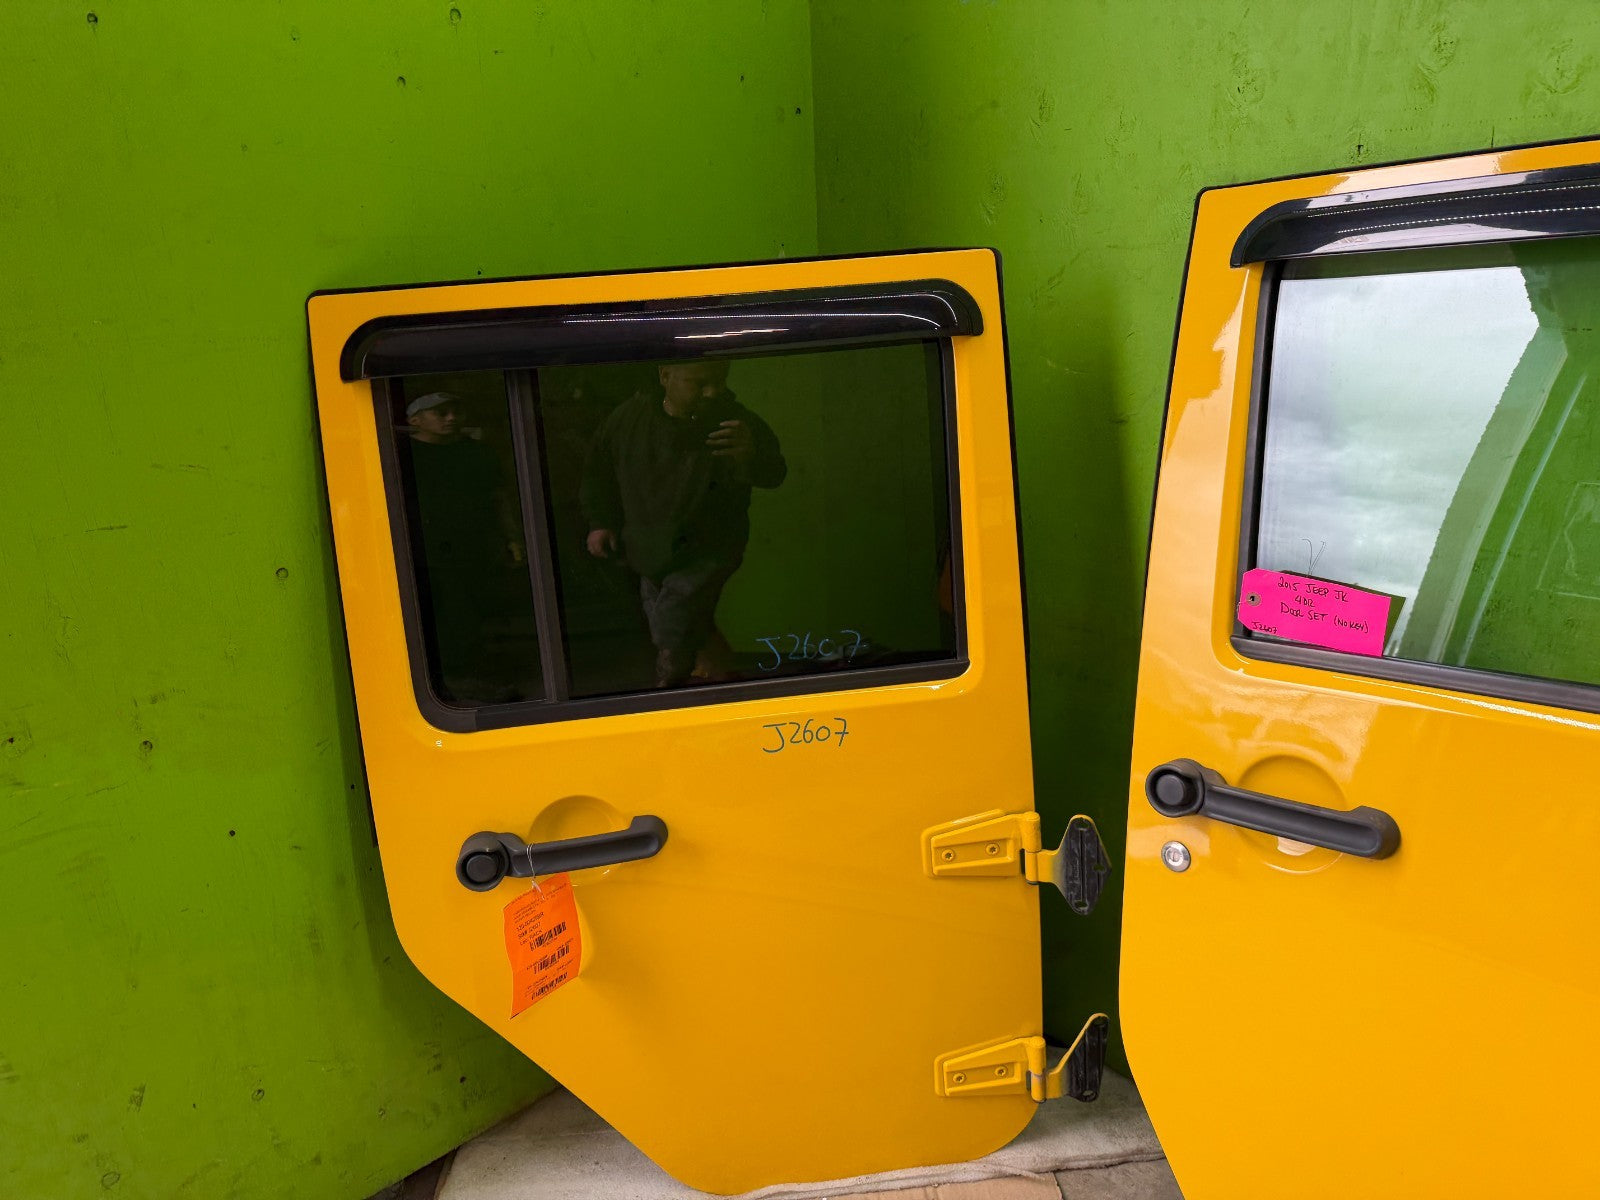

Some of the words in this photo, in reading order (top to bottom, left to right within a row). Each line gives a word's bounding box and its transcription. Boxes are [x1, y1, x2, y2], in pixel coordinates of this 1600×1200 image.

[1278, 576, 1300, 592] 2015
[1305, 583, 1329, 597] JEEP
[1334, 589, 1348, 602] JK
[1307, 609, 1328, 621] SET
[755, 629, 868, 671] J2607
[762, 717, 849, 753] J2607
